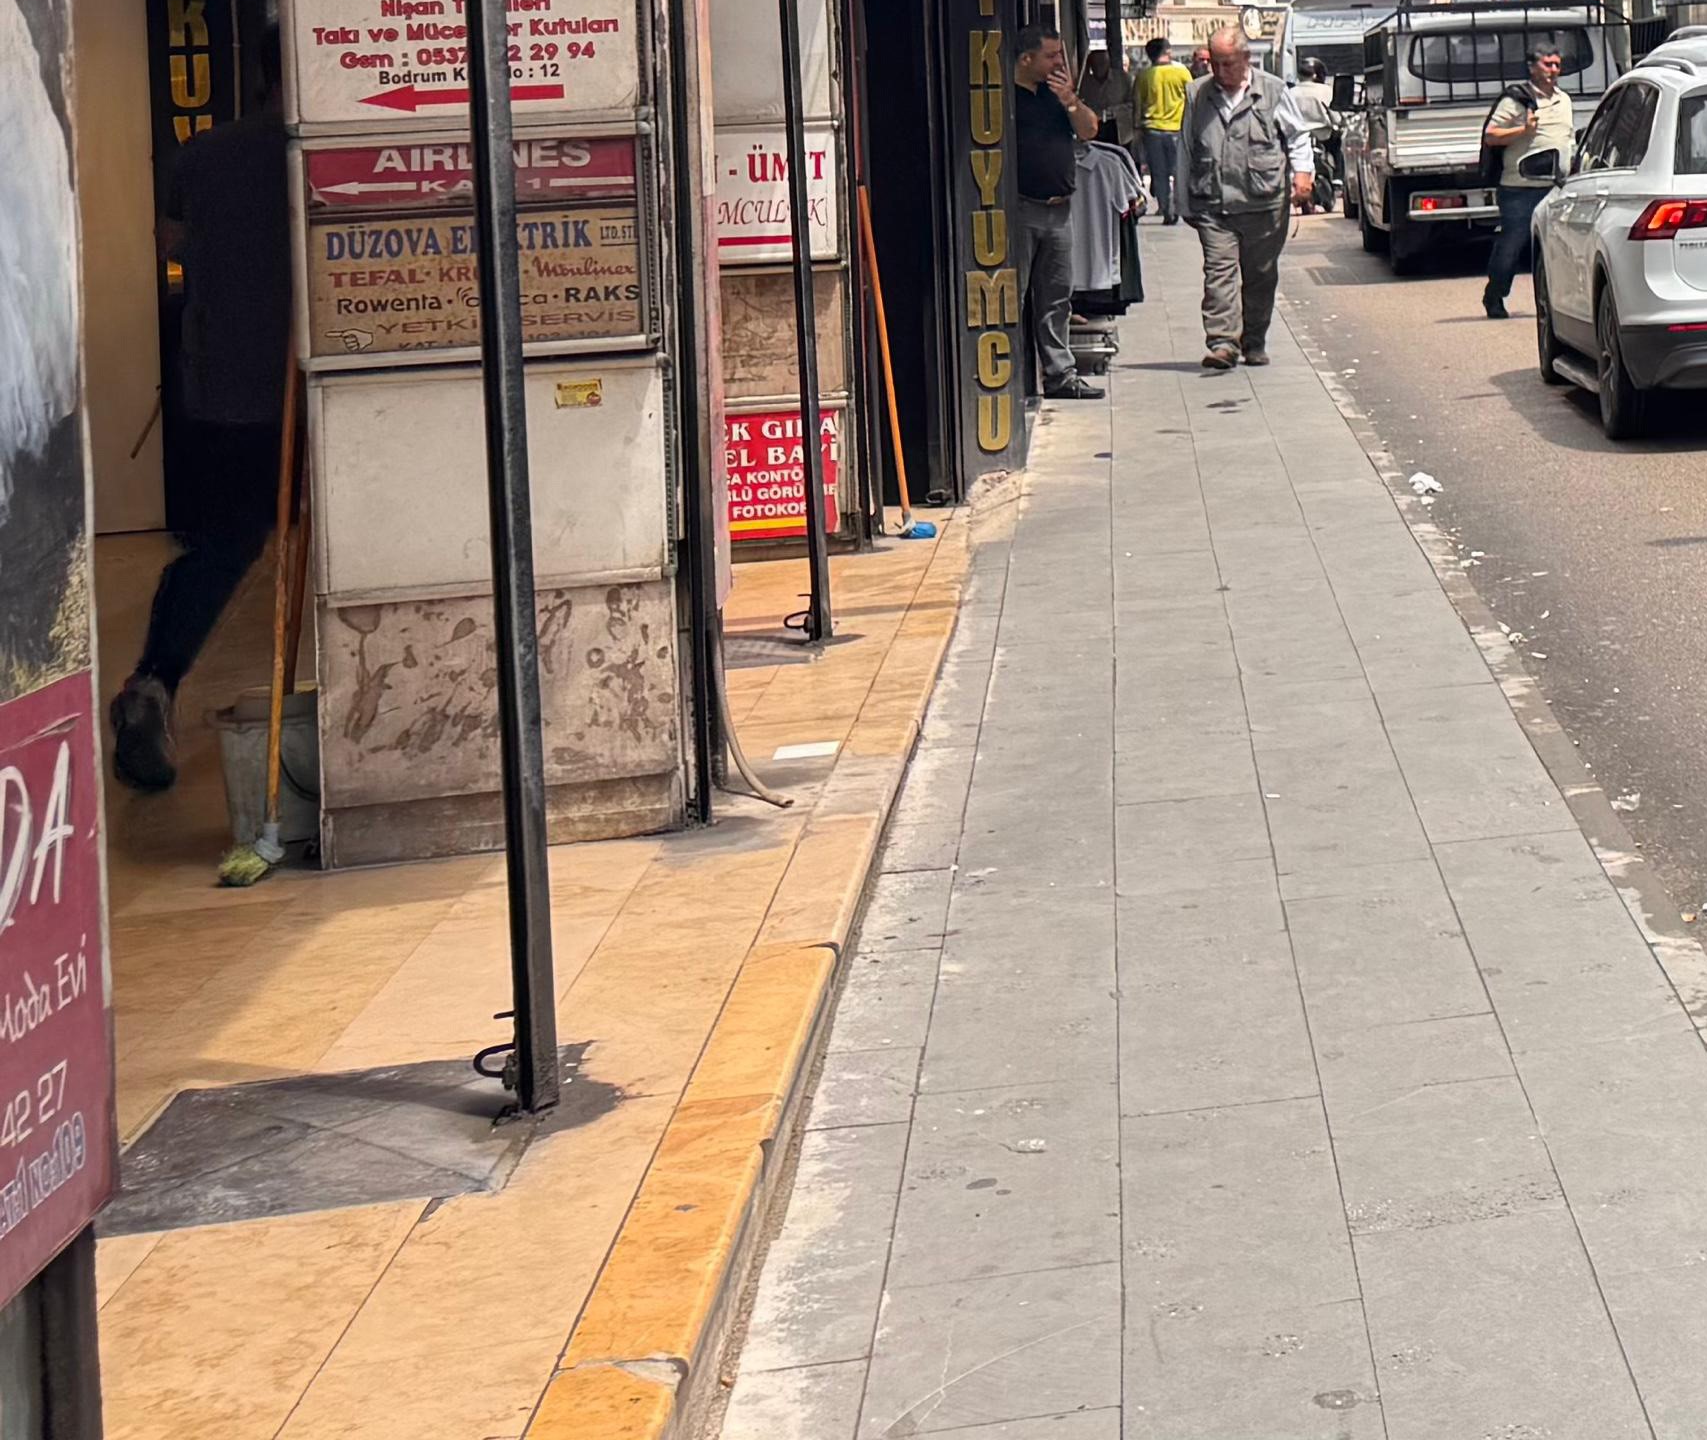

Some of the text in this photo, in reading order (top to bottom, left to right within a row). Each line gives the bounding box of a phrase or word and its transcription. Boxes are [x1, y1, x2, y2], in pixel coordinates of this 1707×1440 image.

[368, 26, 399, 43] ve
[340, 51, 394, 70] Gsm
[530, 43, 558, 60] 29
[567, 41, 596, 59] 94
[379, 69, 448, 85] Bodrum
[540, 63, 560, 78] 12
[373, 140, 591, 173] AIRLNES
[747, 144, 826, 183] ÜMT
[326, 225, 443, 262] DÜZOVA
[966, 30, 1018, 452] KUYUMCU
[329, 266, 426, 288] TEFAL
[337, 293, 443, 316] Rowenta
[565, 285, 641, 304] RAKS
[746, 467, 804, 484] KONTÖ
